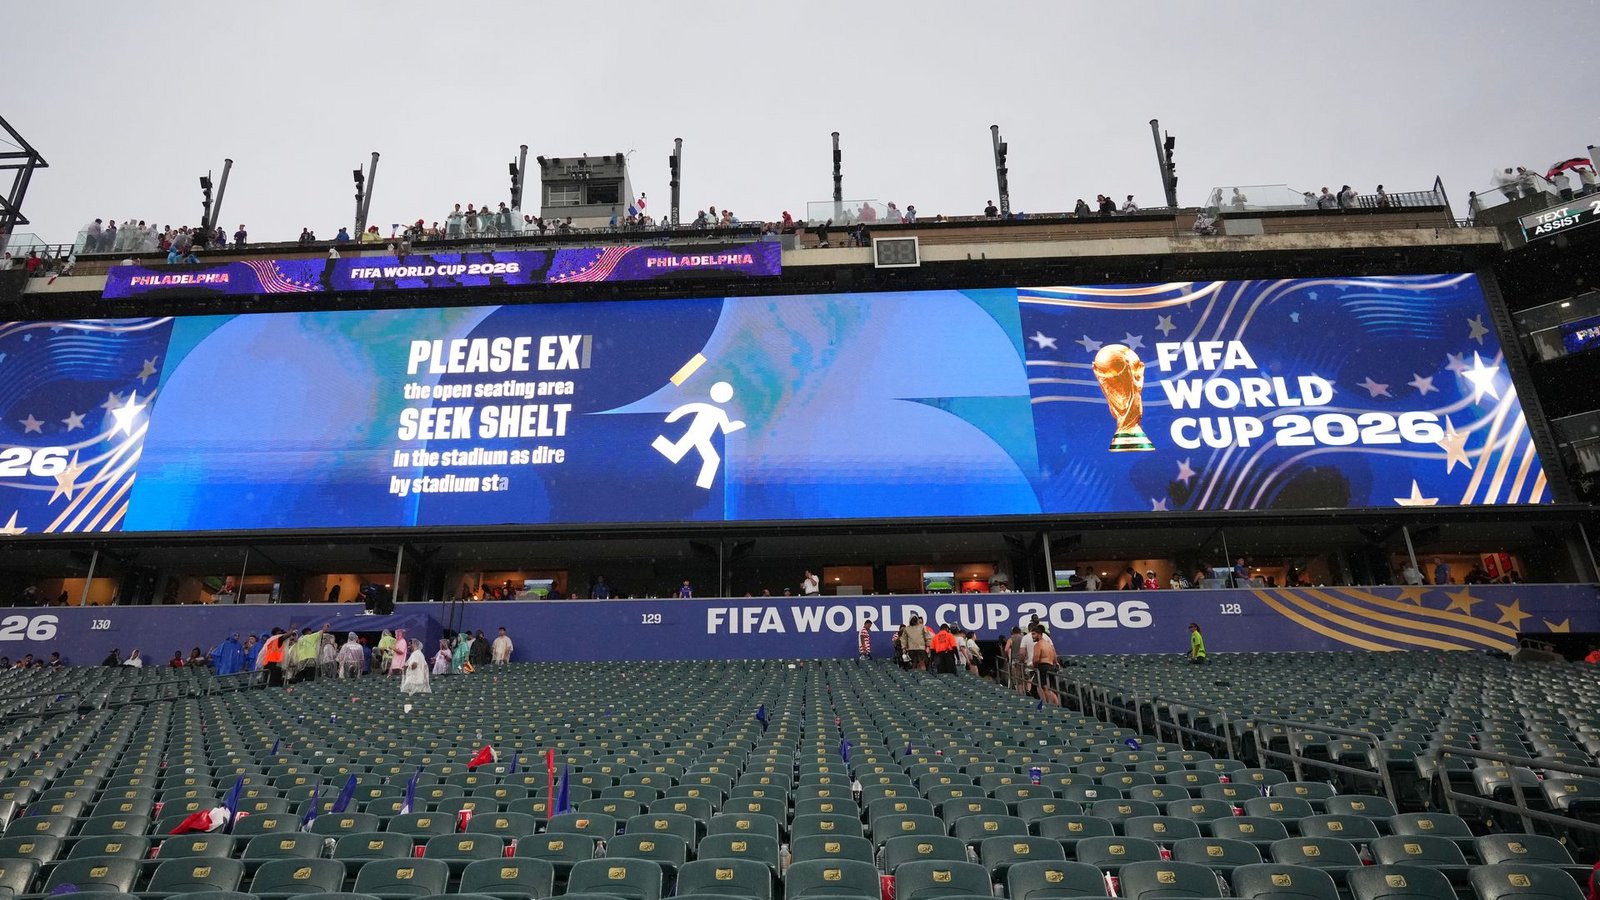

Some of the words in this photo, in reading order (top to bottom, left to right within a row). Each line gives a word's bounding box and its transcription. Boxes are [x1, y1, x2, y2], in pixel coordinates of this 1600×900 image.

[1535, 213, 1581, 235] ASSIST
[1536, 207, 1569, 224] TEXT
[351, 268, 382, 278] FIFA
[384, 265, 435, 278] WORLD
[437, 264, 467, 276] CUP
[468, 262, 519, 275] 2026
[647, 254, 753, 267] PHILADELPHIA
[130, 273, 229, 286] PHILADELPHIA
[407, 336, 532, 375] PLEASE
[1156, 341, 1257, 371] FIFA
[404, 382, 431, 399] the
[432, 384, 472, 401] open
[474, 380, 536, 399] seating
[538, 381, 574, 395] area
[1160, 375, 1333, 410] WORLD
[397, 406, 475, 441] SEEK
[478, 403, 572, 438] SHELT
[1170, 416, 1264, 449] CUP
[1272, 411, 1445, 446] 2026
[0, 446, 69, 477] 26
[393, 450, 409, 467] in
[411, 449, 440, 466] the
[441, 448, 508, 466] stadium
[510, 450, 530, 464] as
[532, 446, 565, 464] dire
[389, 475, 411, 496] by
[412, 474, 479, 493] stadium
[641, 613, 662, 625] 129
[707, 606, 786, 634] FIFA
[791, 604, 928, 633] WORLD
[935, 603, 1010, 631] CUP
[1017, 600, 1153, 630] 2026
[1219, 603, 1242, 615] 128
[0, 614, 59, 641] 26
[91, 619, 111, 630] 130
